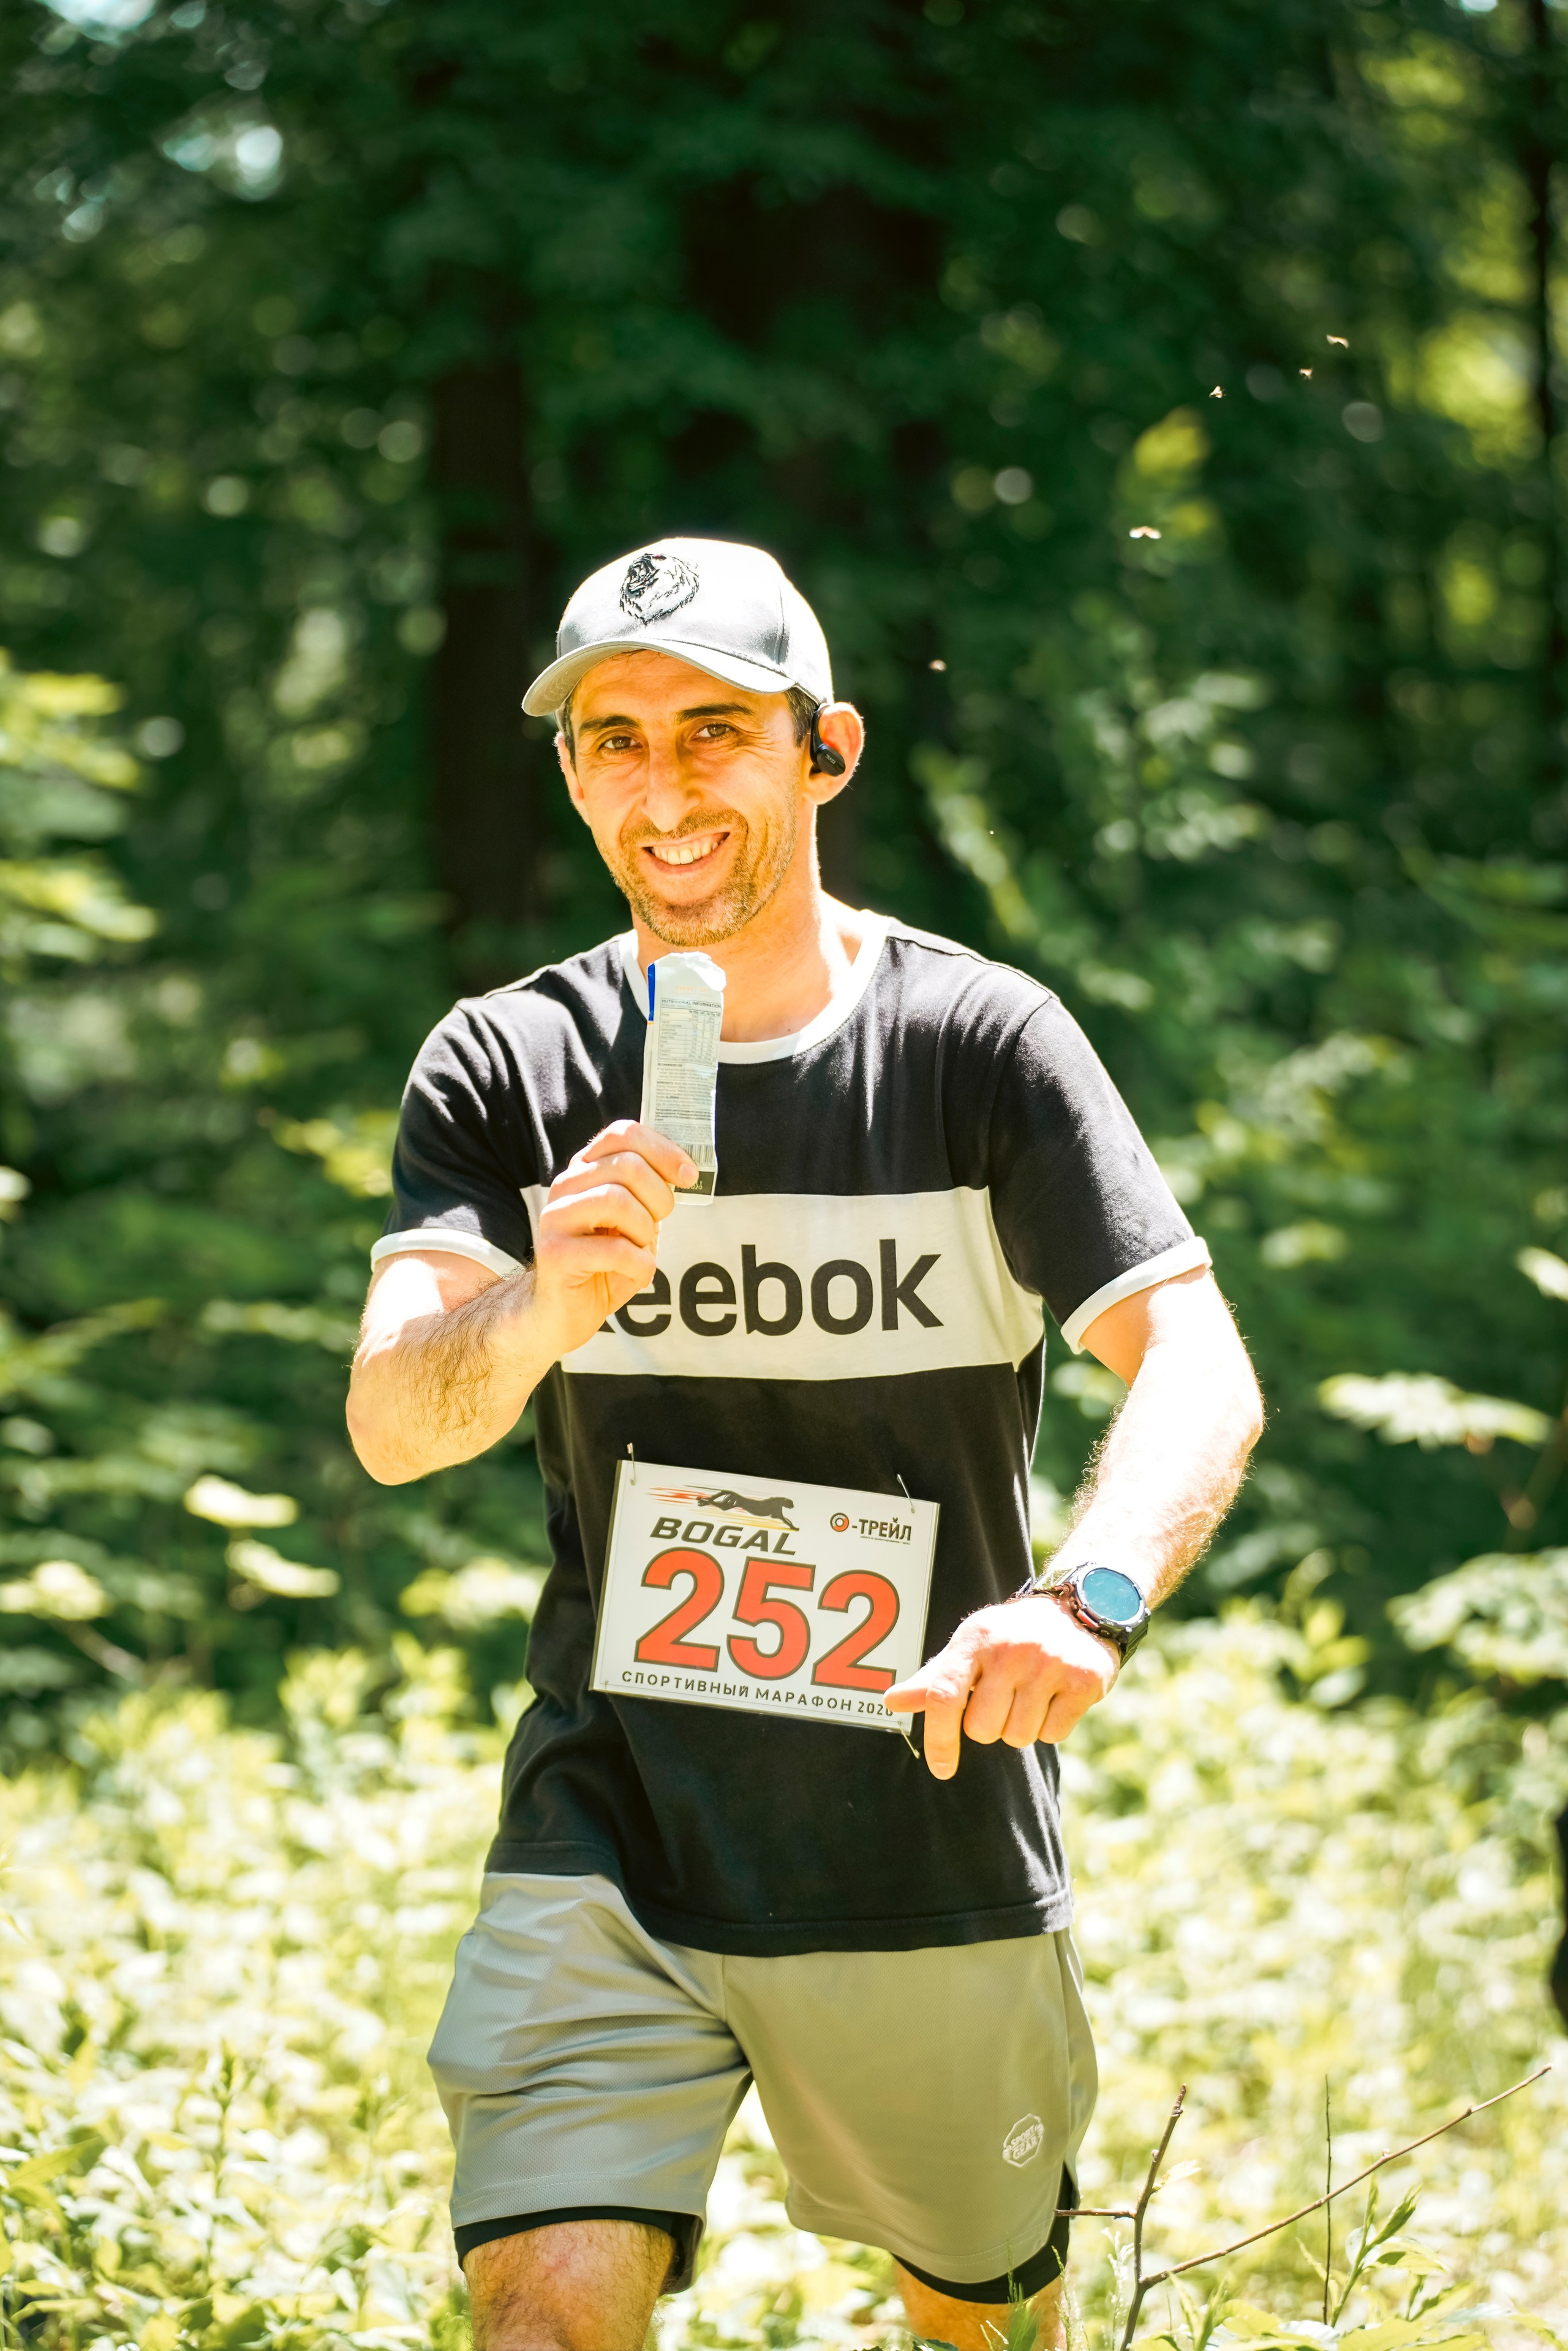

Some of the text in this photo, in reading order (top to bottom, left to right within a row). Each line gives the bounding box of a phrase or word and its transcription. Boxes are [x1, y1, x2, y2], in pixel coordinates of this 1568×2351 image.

[598, 1238, 944, 1337] eebok
[649, 1517, 798, 1555] BOGAL
[633, 1546, 900, 1693] 252
[622, 1670, 749, 1698] СПОРТИВНЫЙ
[755, 1688, 851, 1711] МАРАФОН
[1011, 2124, 1035, 2147] SPORT
[1012, 2136, 1038, 2159] GEAR
